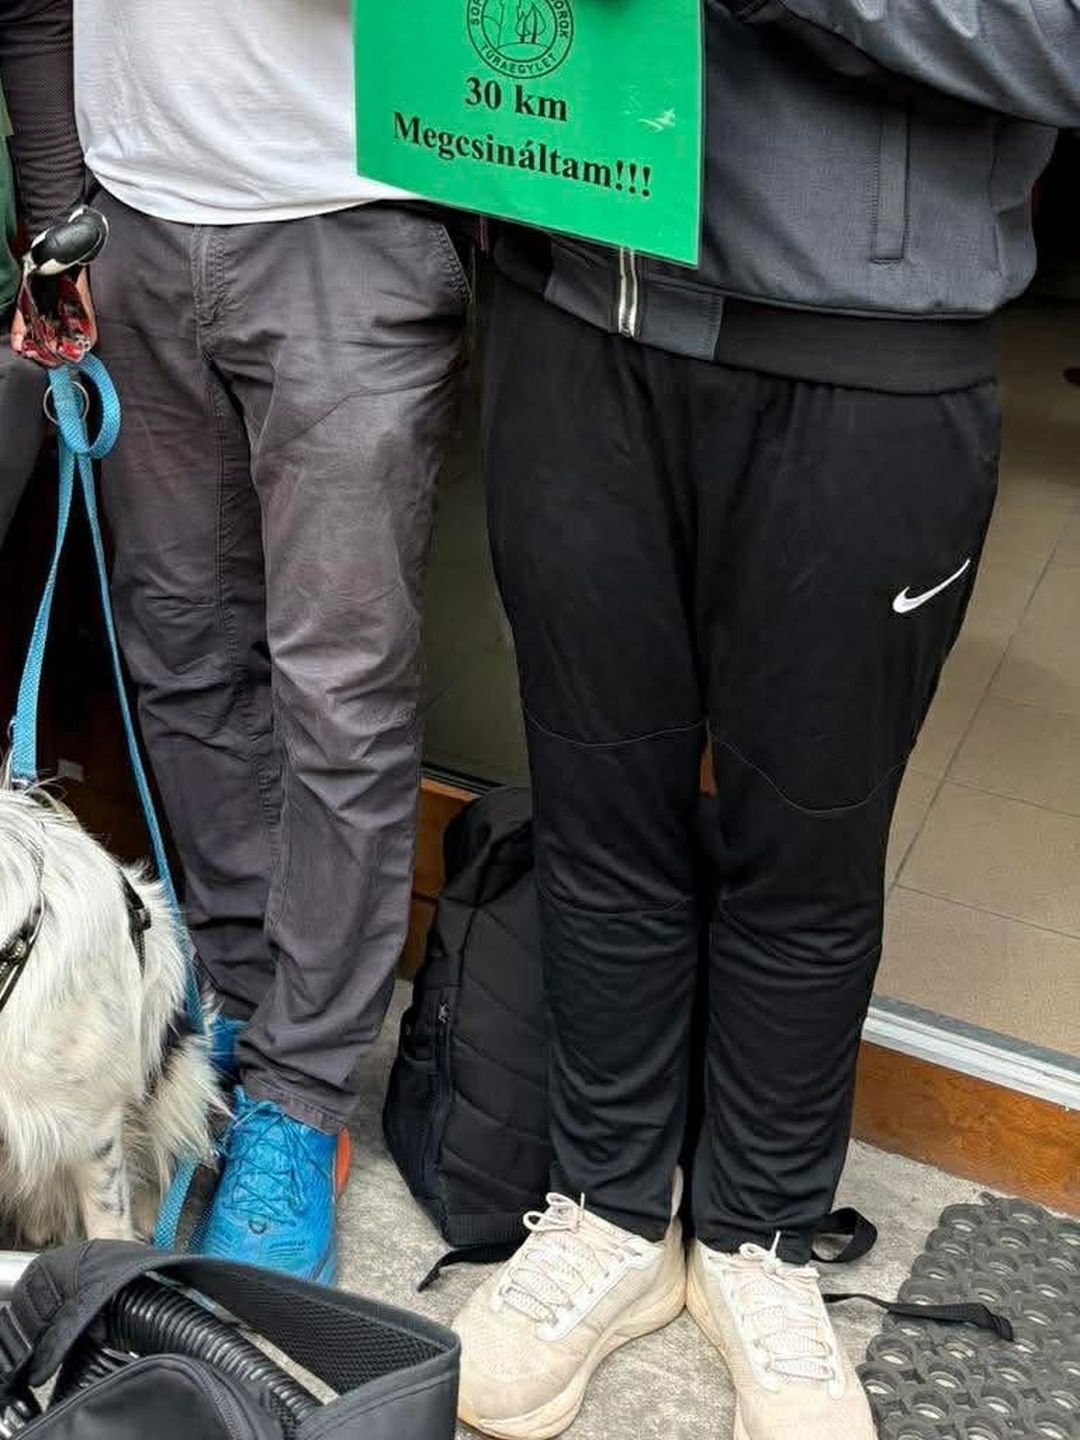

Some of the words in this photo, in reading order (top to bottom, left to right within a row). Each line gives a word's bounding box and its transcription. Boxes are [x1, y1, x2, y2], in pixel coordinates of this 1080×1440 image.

[464, 76, 502, 110] 30
[515, 84, 569, 122] km
[393, 111, 652, 198] Megcsináltam!!!
